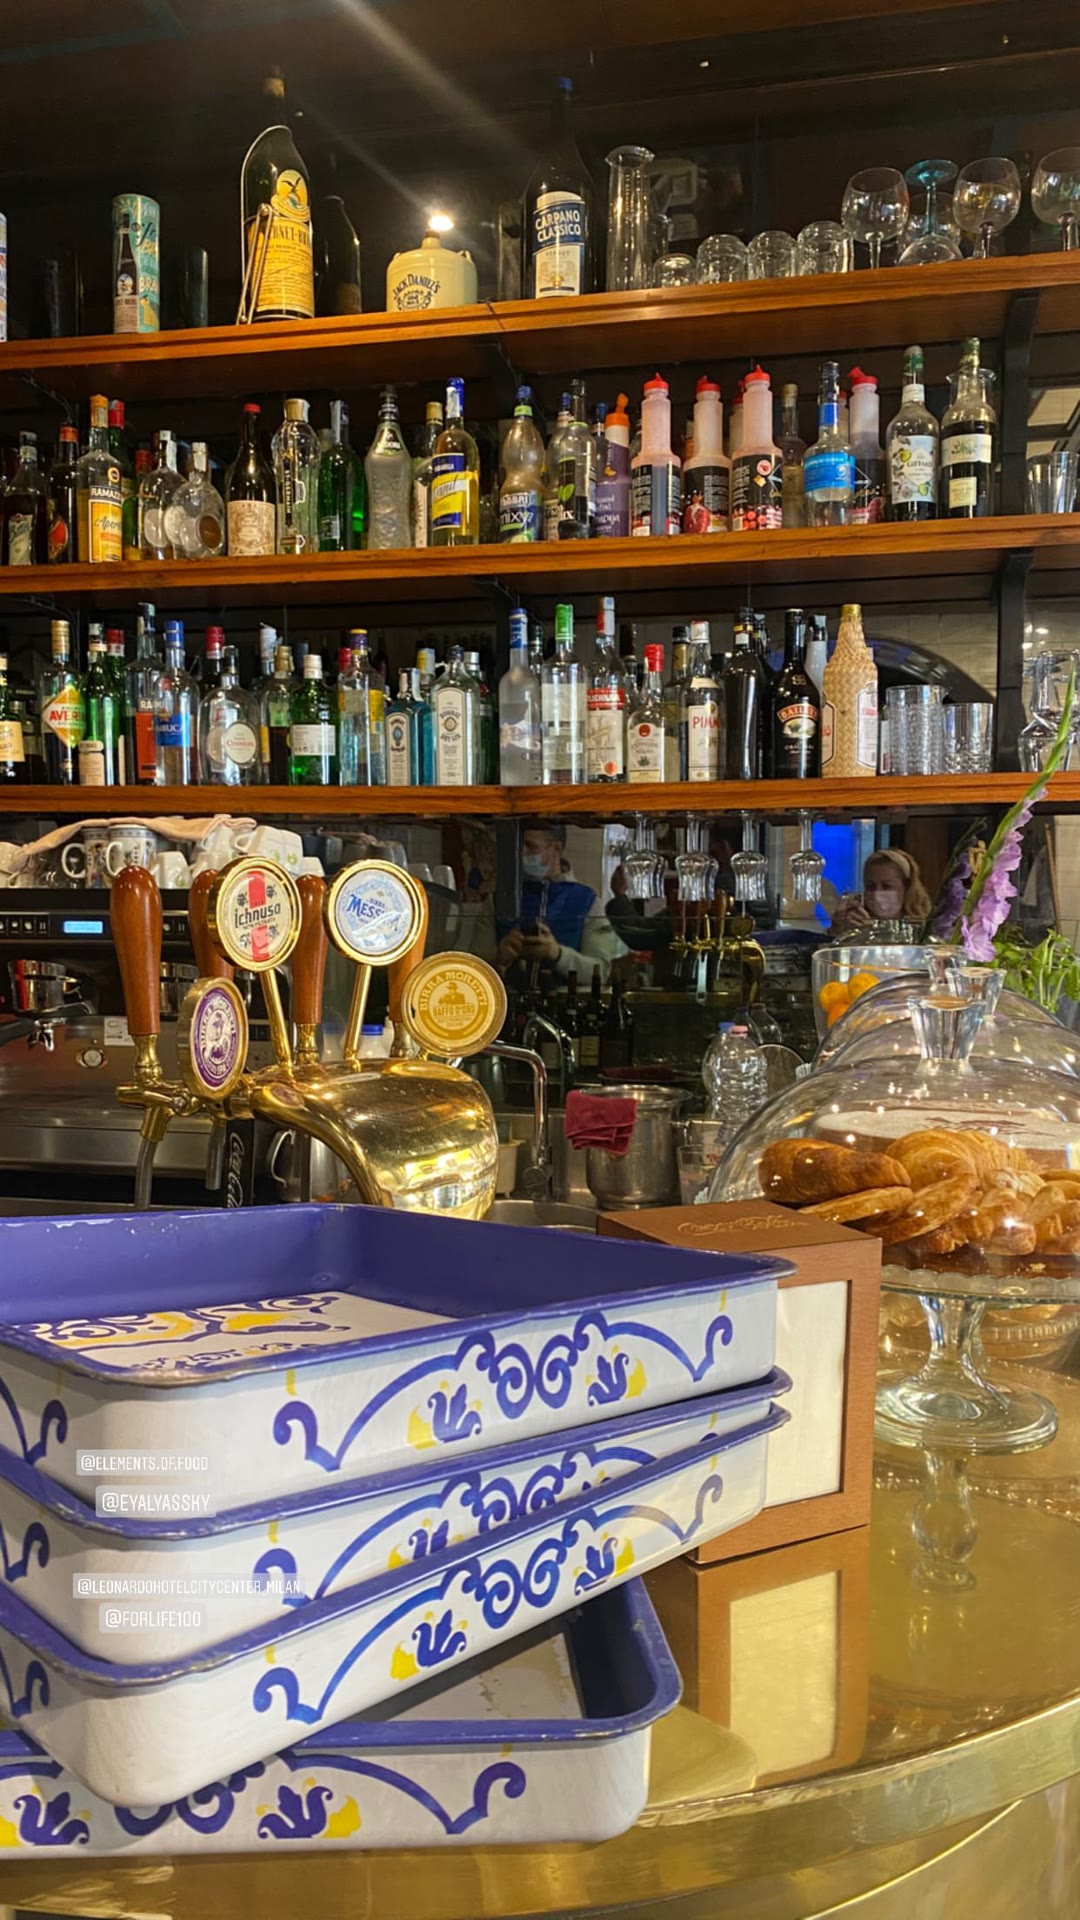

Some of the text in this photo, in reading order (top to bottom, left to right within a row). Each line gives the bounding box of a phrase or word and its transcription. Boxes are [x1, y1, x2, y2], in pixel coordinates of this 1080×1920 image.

[535, 209, 580, 230] CARPANO
[537, 223, 582, 242] CLASSICO
[234, 903, 281, 929] ichnusa
[346, 893, 385, 917] MESS
[420, 971, 488, 1011] BIRRA MORETTI
